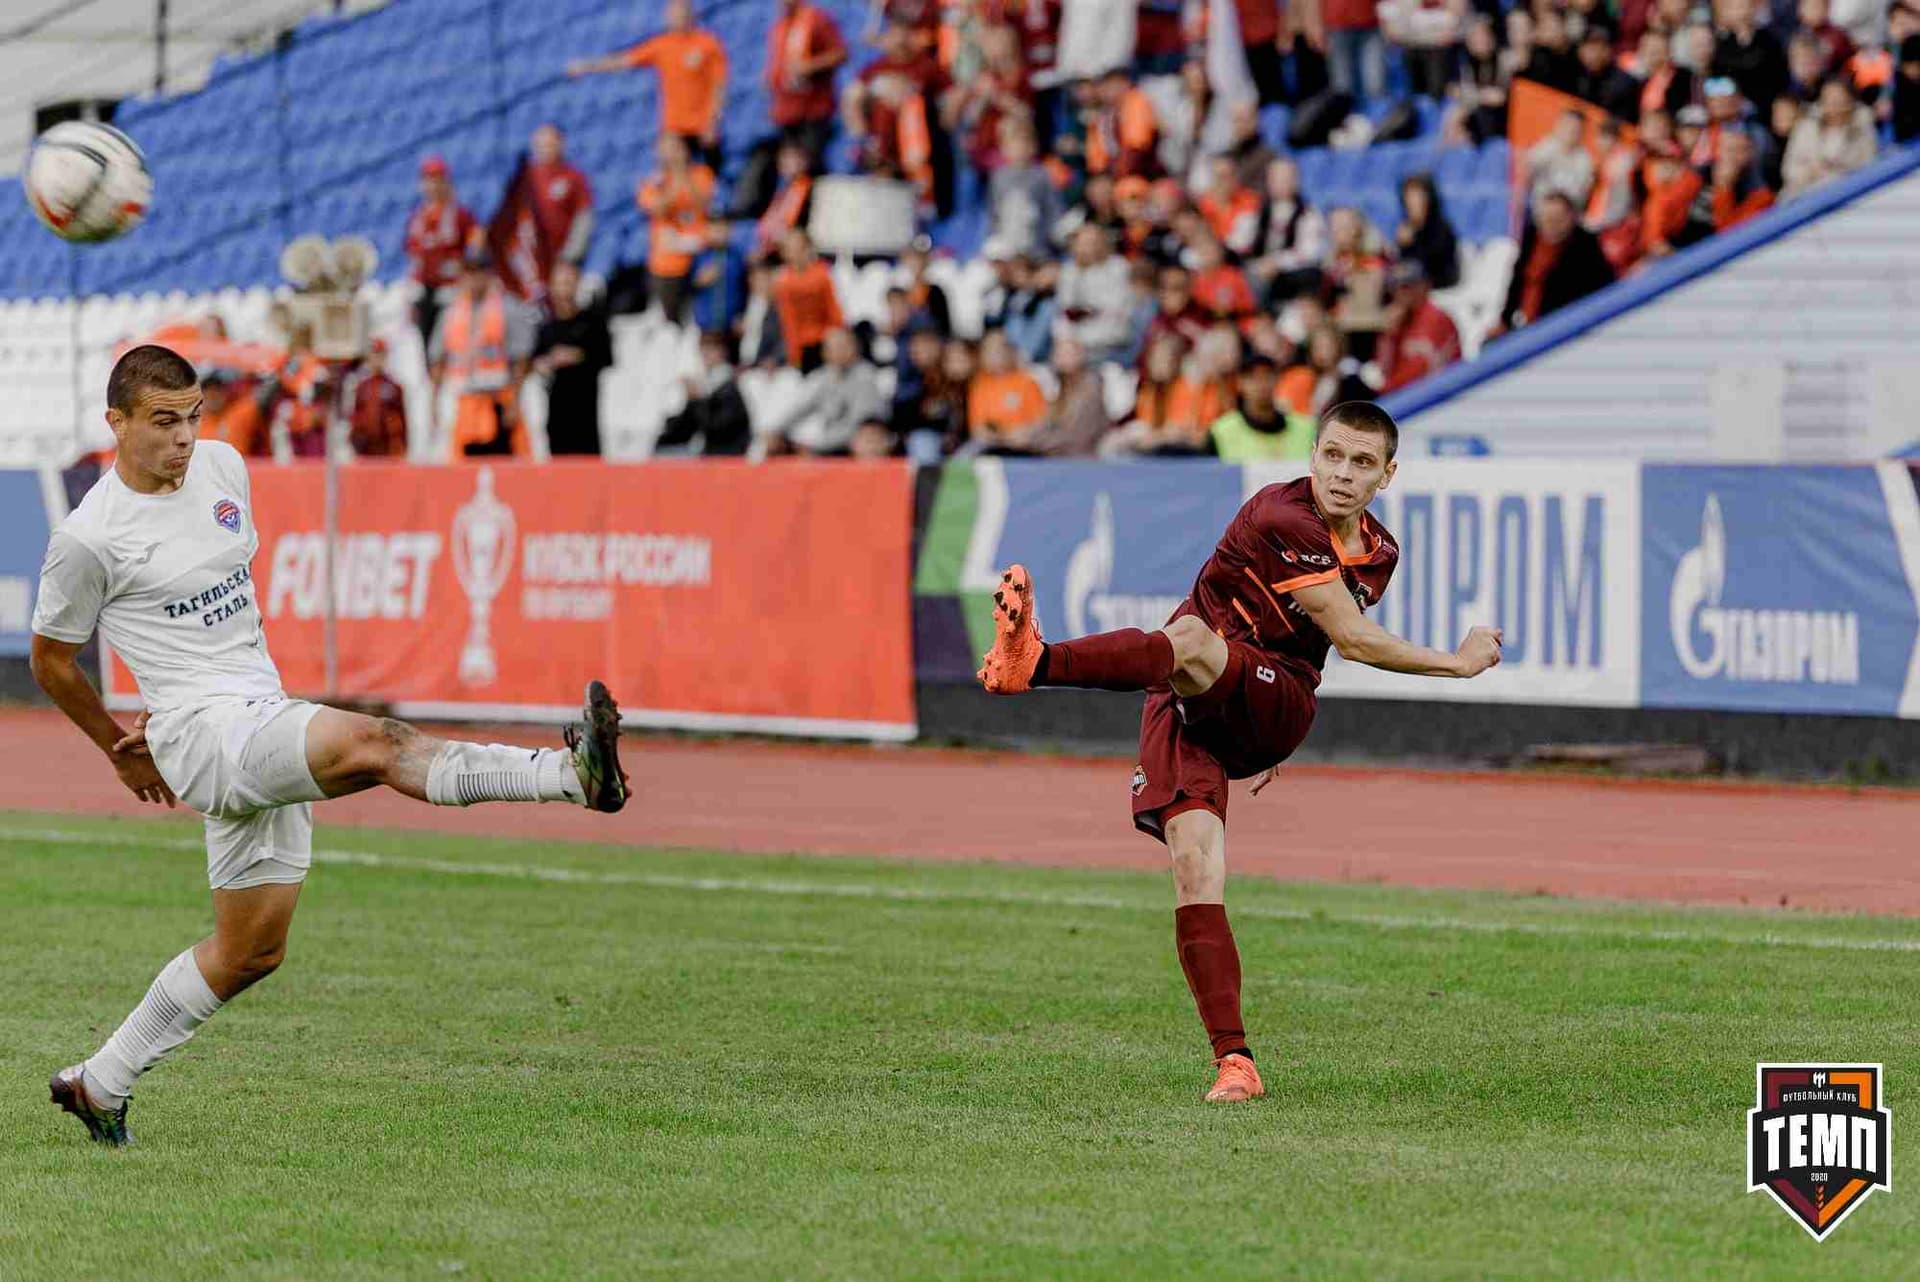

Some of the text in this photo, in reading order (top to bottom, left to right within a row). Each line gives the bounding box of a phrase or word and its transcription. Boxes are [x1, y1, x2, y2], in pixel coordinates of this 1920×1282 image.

[202, 594, 248, 627] СТАЛЬ
[268, 531, 442, 620] FONBET
[1374, 494, 1602, 666] ПРОМ
